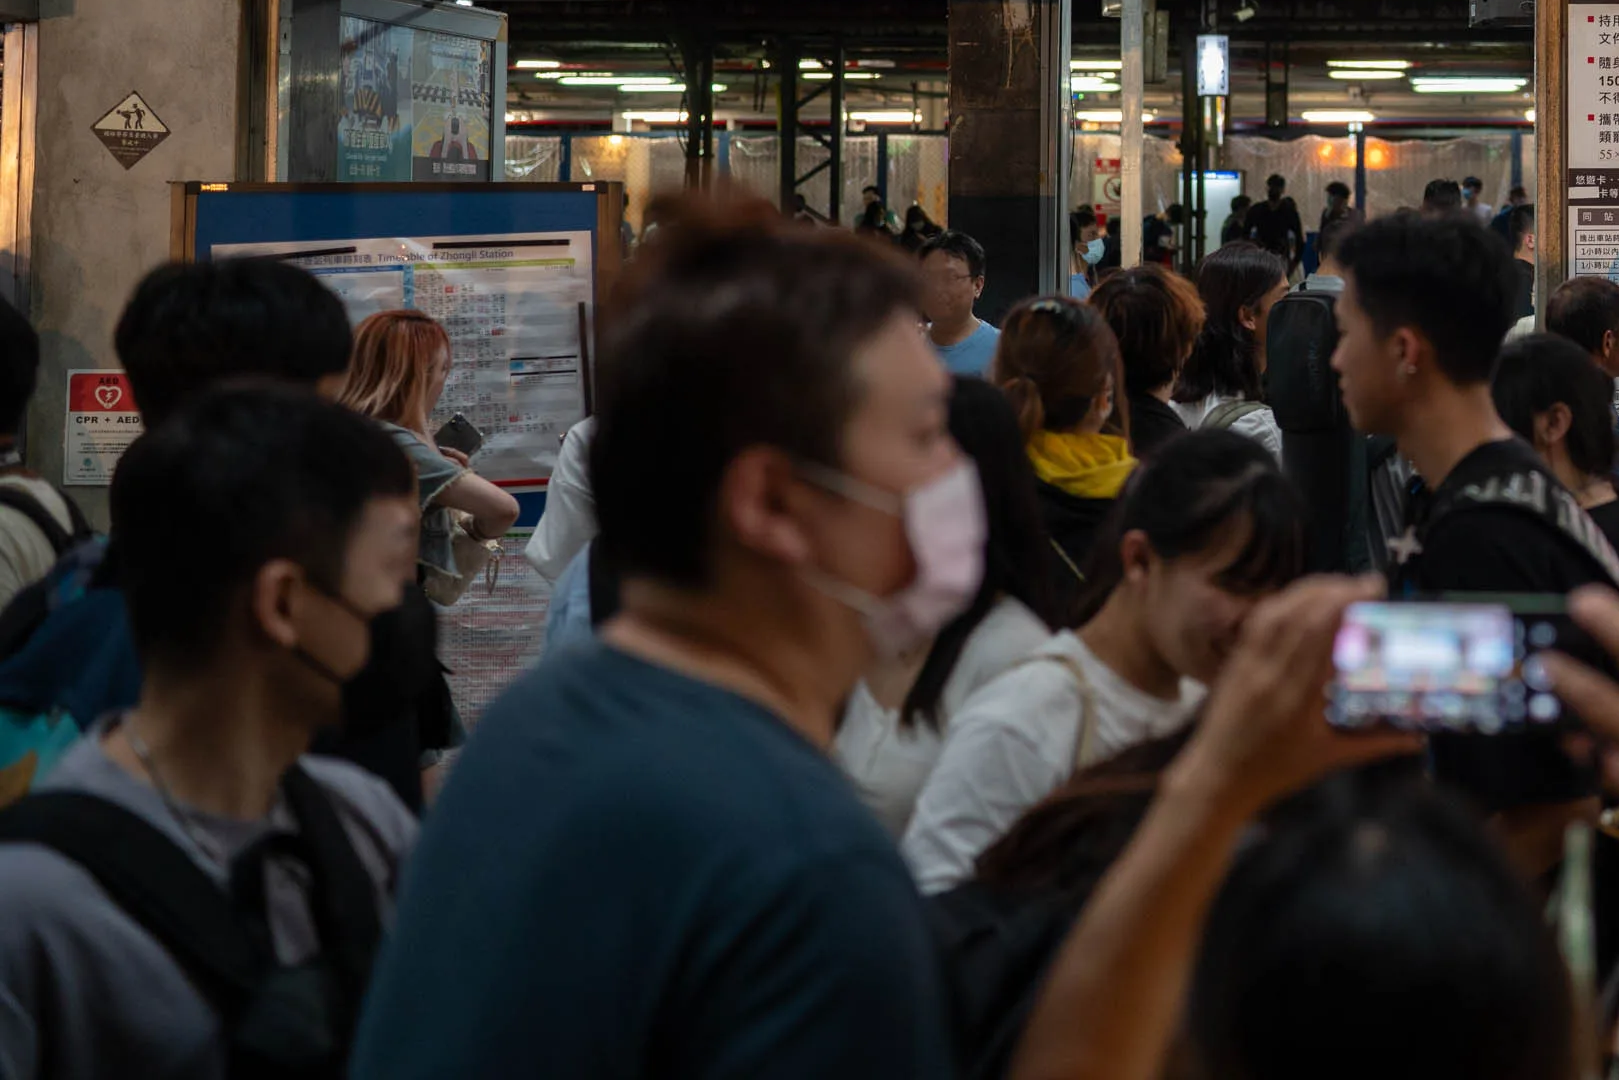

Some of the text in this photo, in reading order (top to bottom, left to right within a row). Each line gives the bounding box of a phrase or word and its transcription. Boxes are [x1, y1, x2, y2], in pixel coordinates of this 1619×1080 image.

[439, 250, 478, 263] Zhongli
[479, 249, 514, 259] Station
[76, 416, 140, 424] CPR AED
